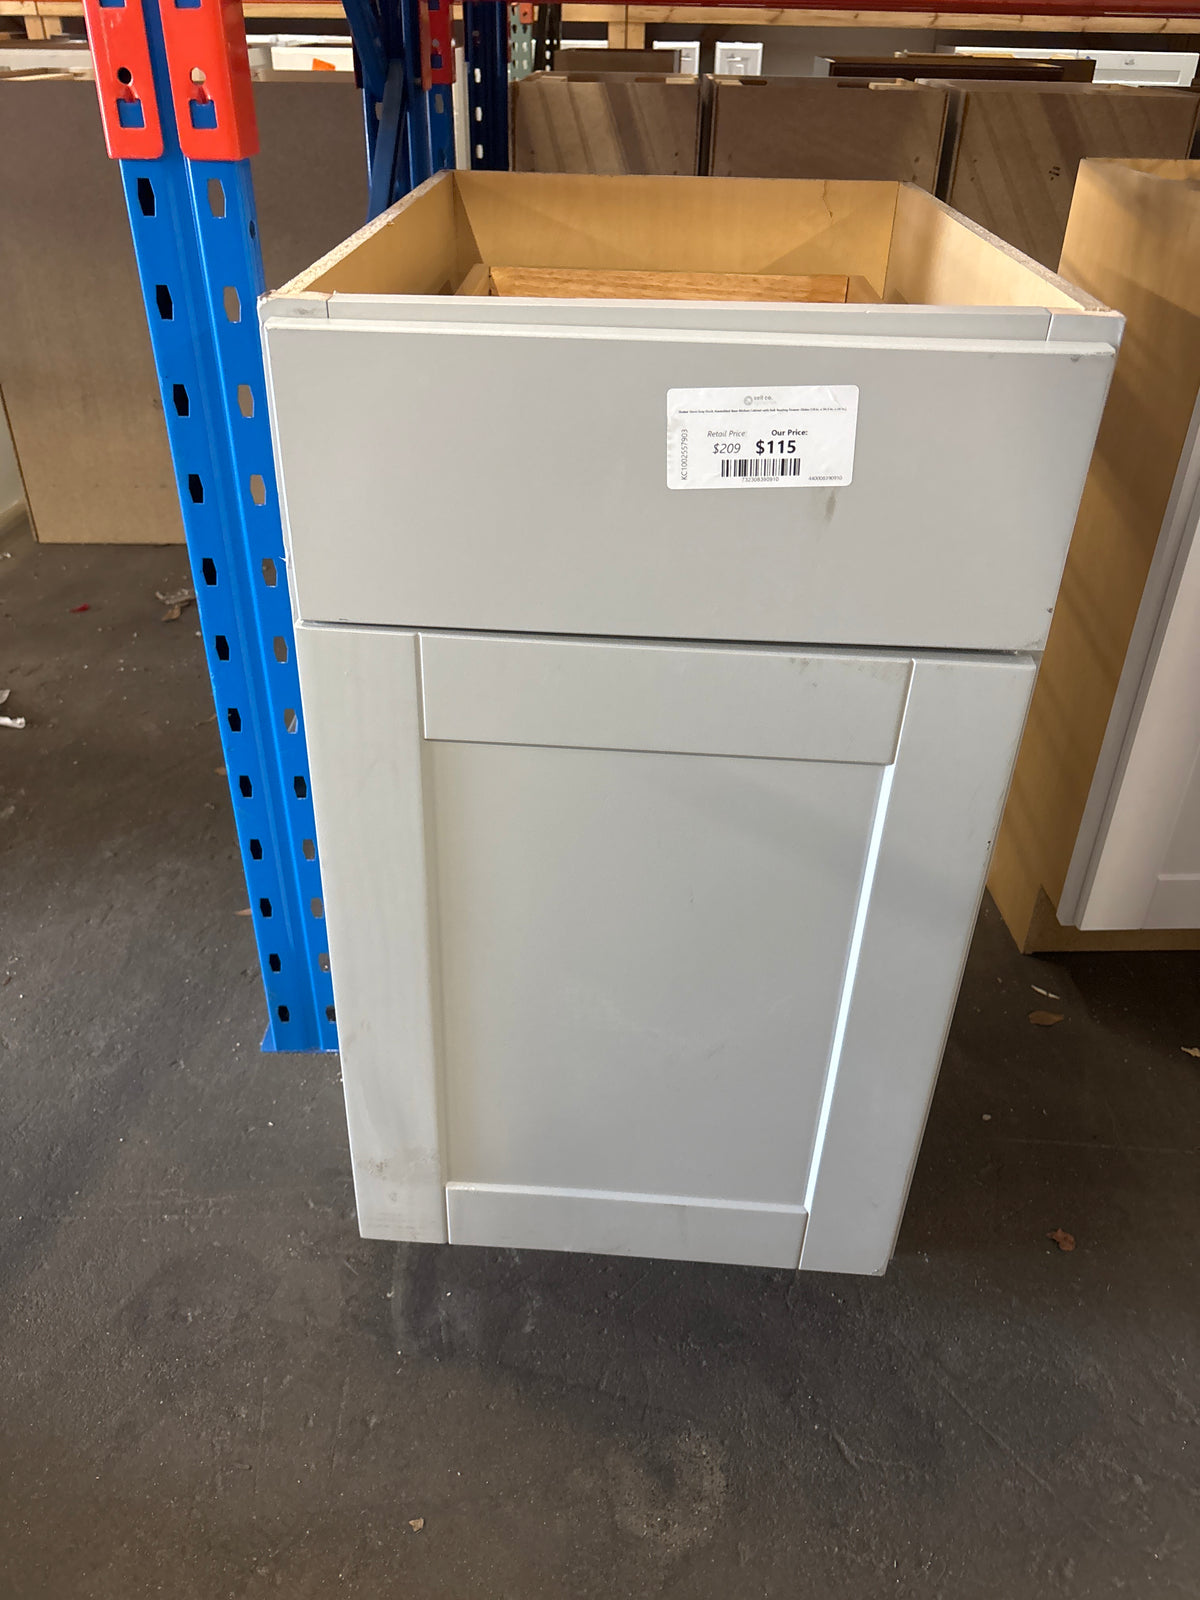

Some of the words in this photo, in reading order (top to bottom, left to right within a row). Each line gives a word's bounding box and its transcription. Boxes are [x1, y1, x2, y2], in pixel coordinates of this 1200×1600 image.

[680, 429, 688, 480] KC1002557903
[712, 442, 741, 454] $209
[756, 439, 796, 456] $115
